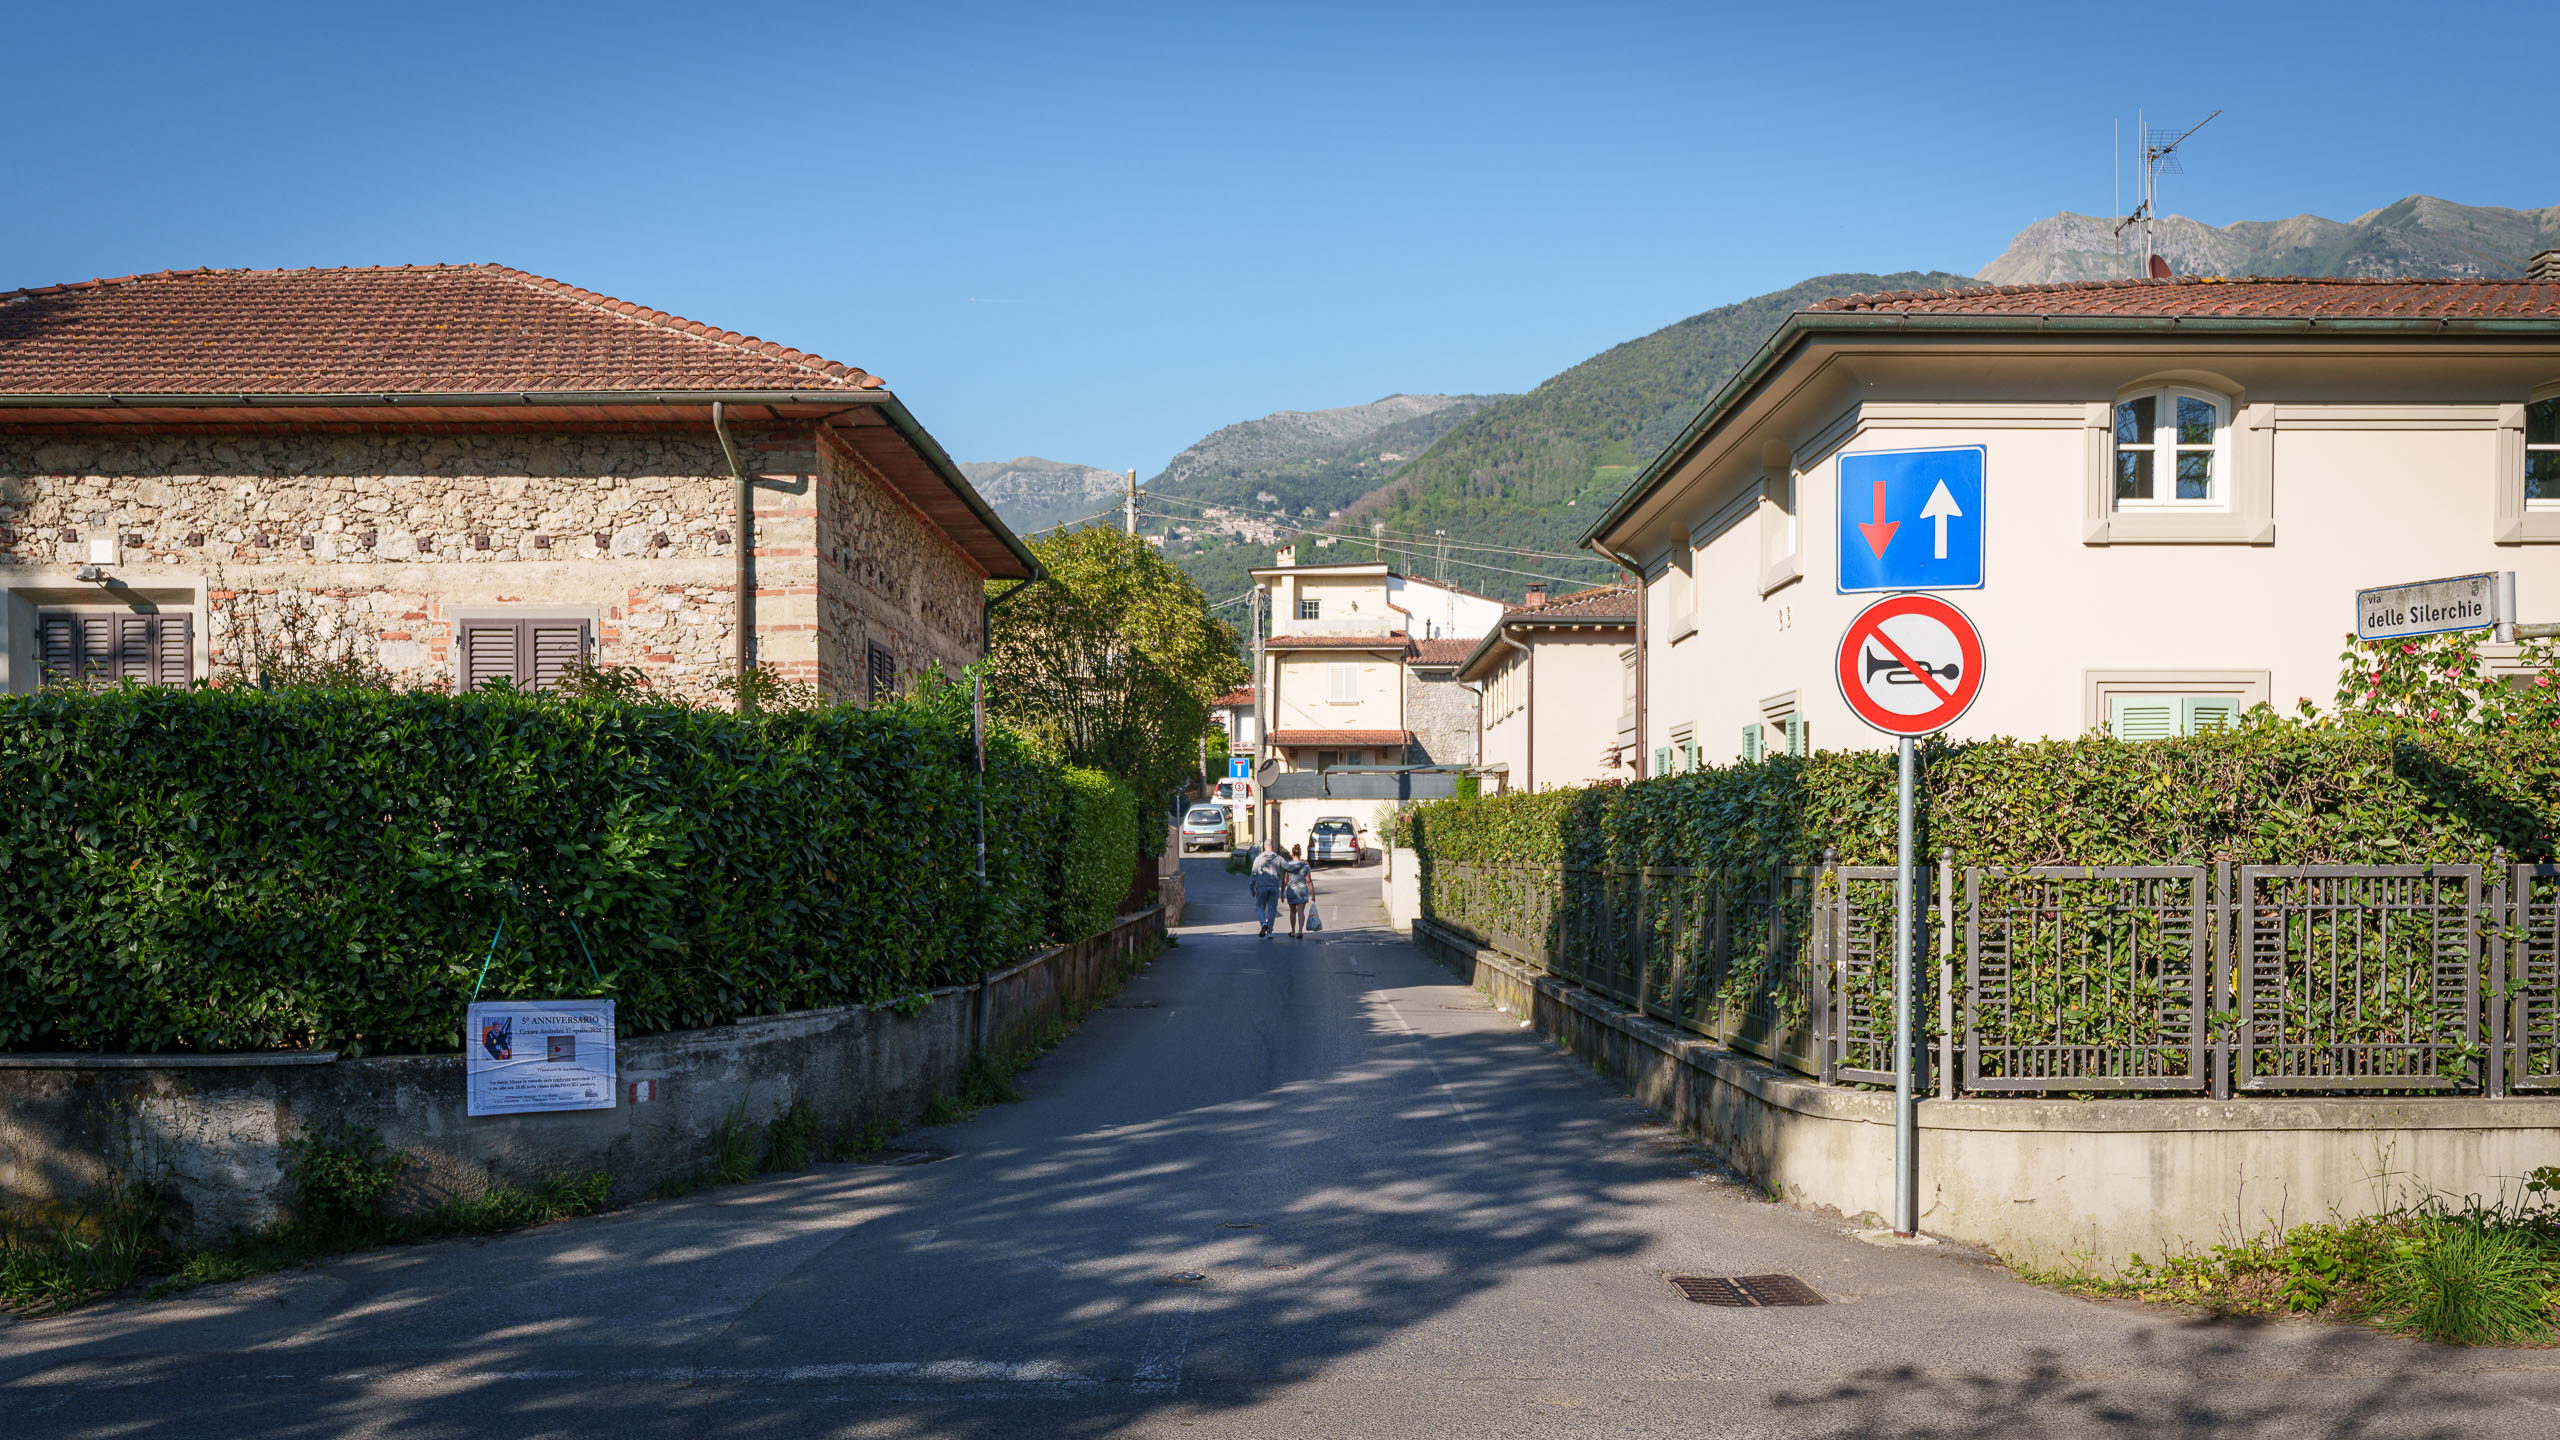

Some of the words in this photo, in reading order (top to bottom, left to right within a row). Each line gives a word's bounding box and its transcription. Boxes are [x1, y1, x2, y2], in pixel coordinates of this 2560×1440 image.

[2368, 594, 2381, 604] via
[2368, 609, 2404, 628] delle
[2410, 600, 2482, 624] Silerchie
[532, 1015, 599, 1025] ANNIVERSARIO
